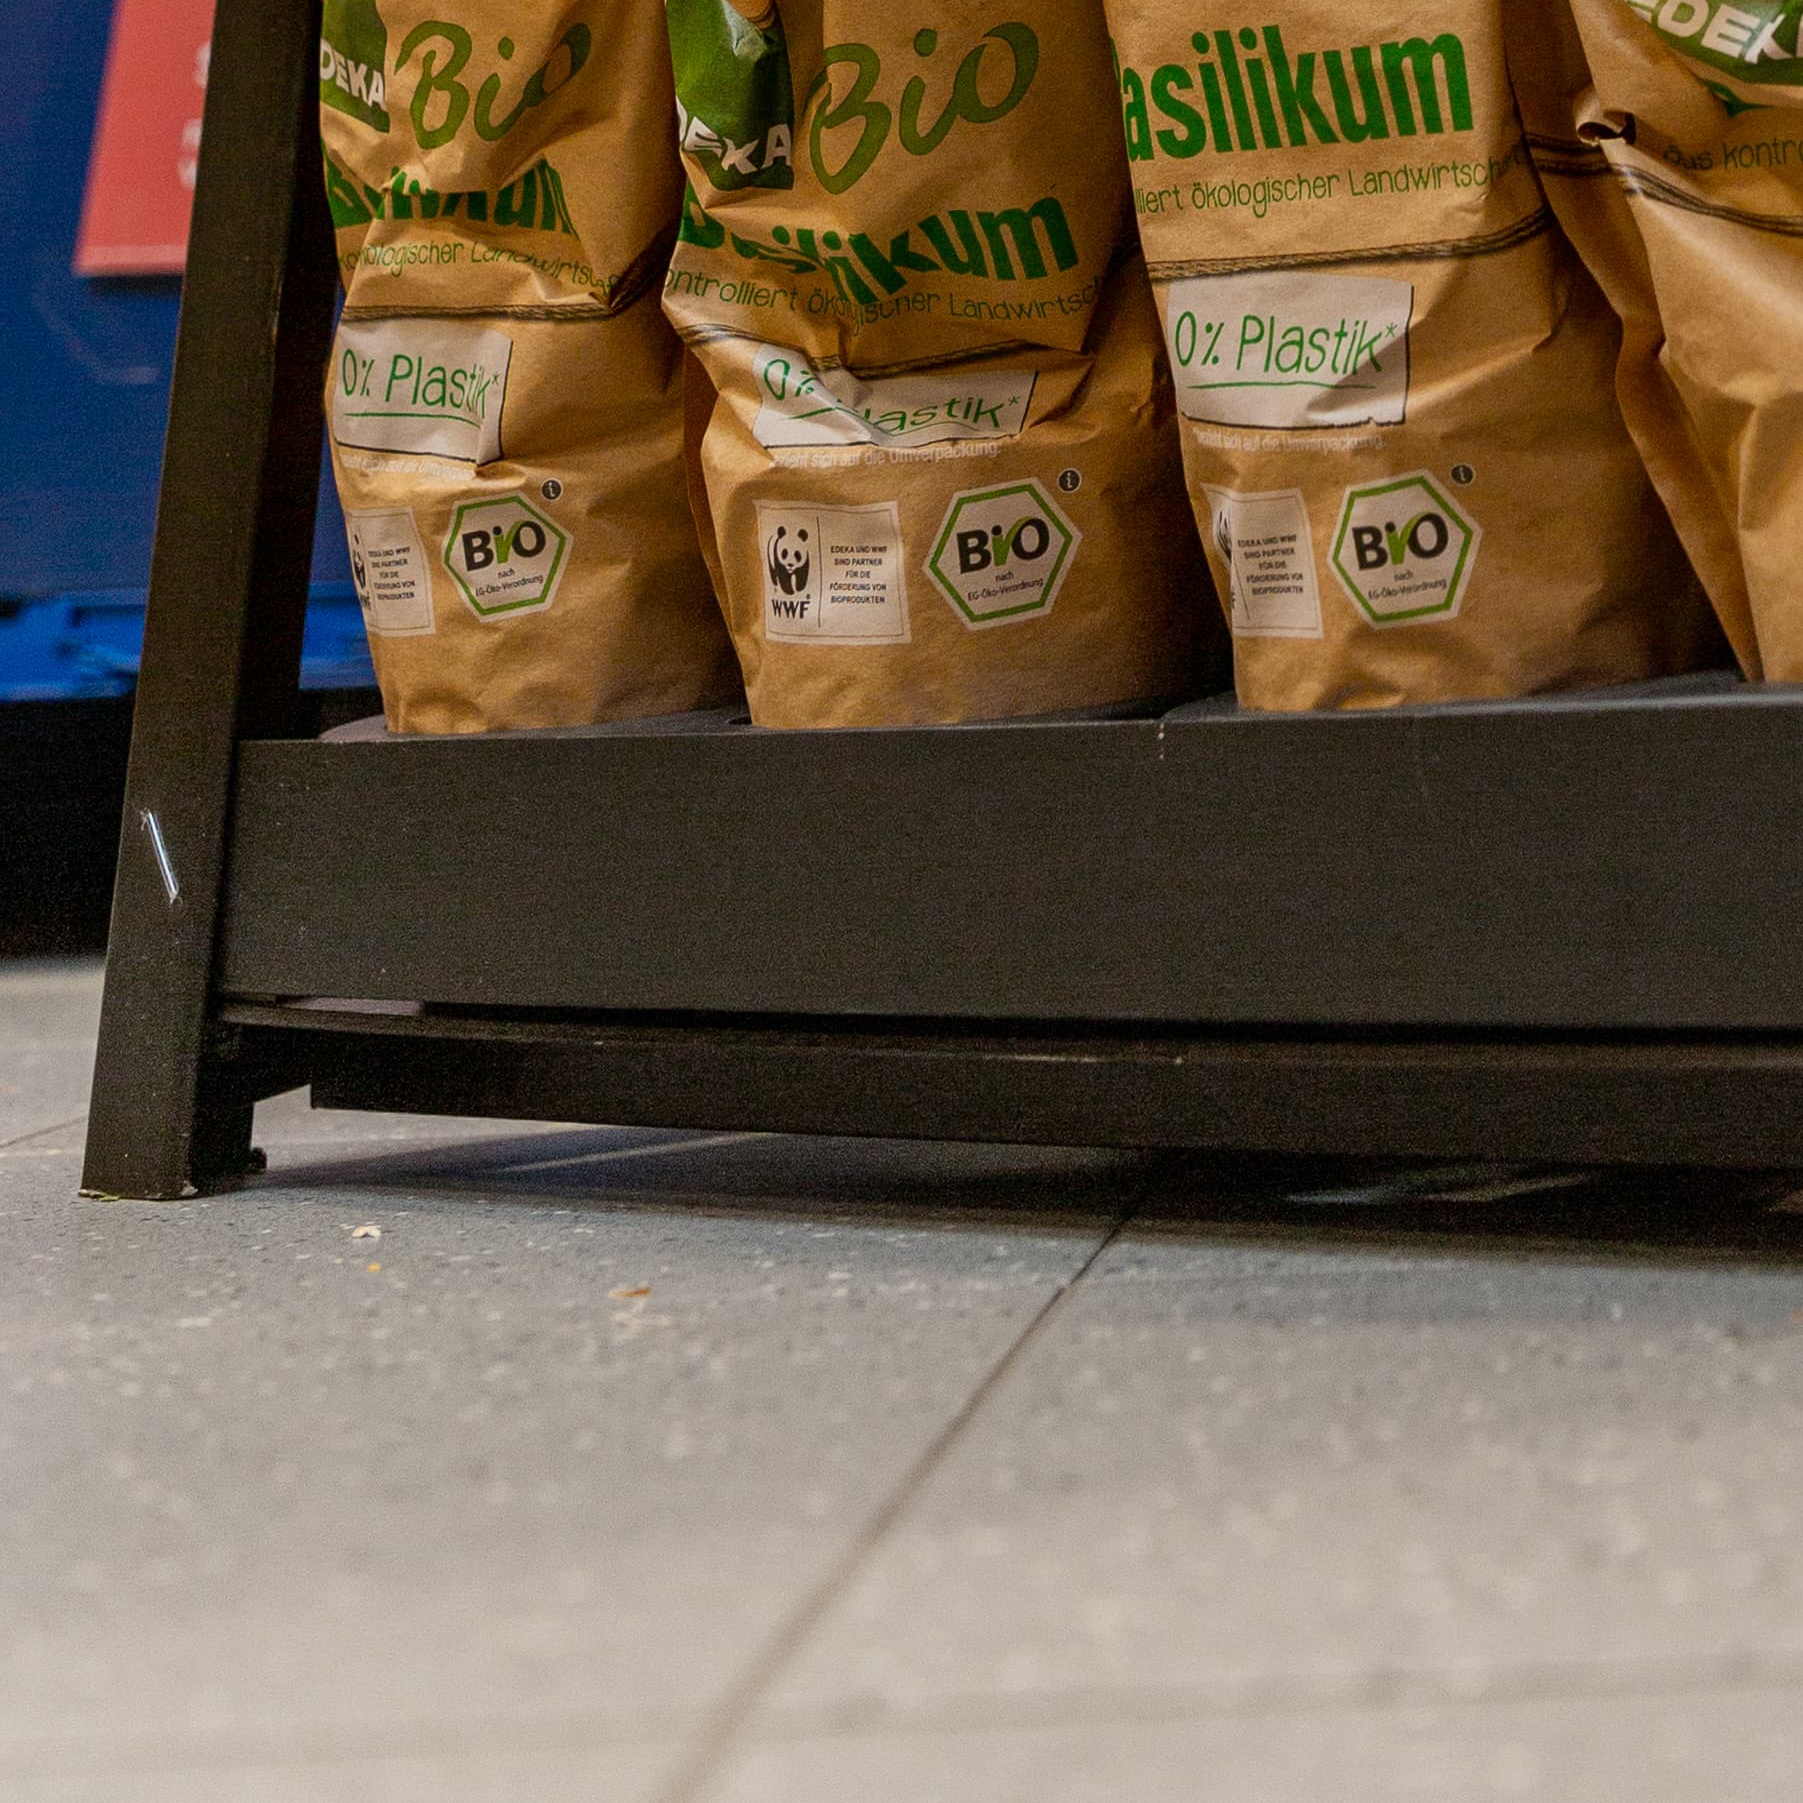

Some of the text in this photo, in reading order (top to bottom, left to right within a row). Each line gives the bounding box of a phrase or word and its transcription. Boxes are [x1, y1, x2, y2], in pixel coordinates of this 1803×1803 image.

[320, 37, 388, 112] DEKA
[394, 20, 591, 150] Bio
[1111, 23, 1474, 163] asilikum
[802, 21, 1040, 194] Bio
[677, 95, 793, 176] DEKA
[1191, 171, 1341, 219] ökologischer
[664, 267, 799, 311] ontrolliert
[1174, 310, 1226, 368] 0%
[342, 348, 376, 397] 0%
[863, 395, 1021, 431] lastik
[863, 449, 885, 465] die
[830, 545, 855, 554] EDEKA
[851, 558, 883, 566] PARTNER
[772, 598, 811, 619] WWF
